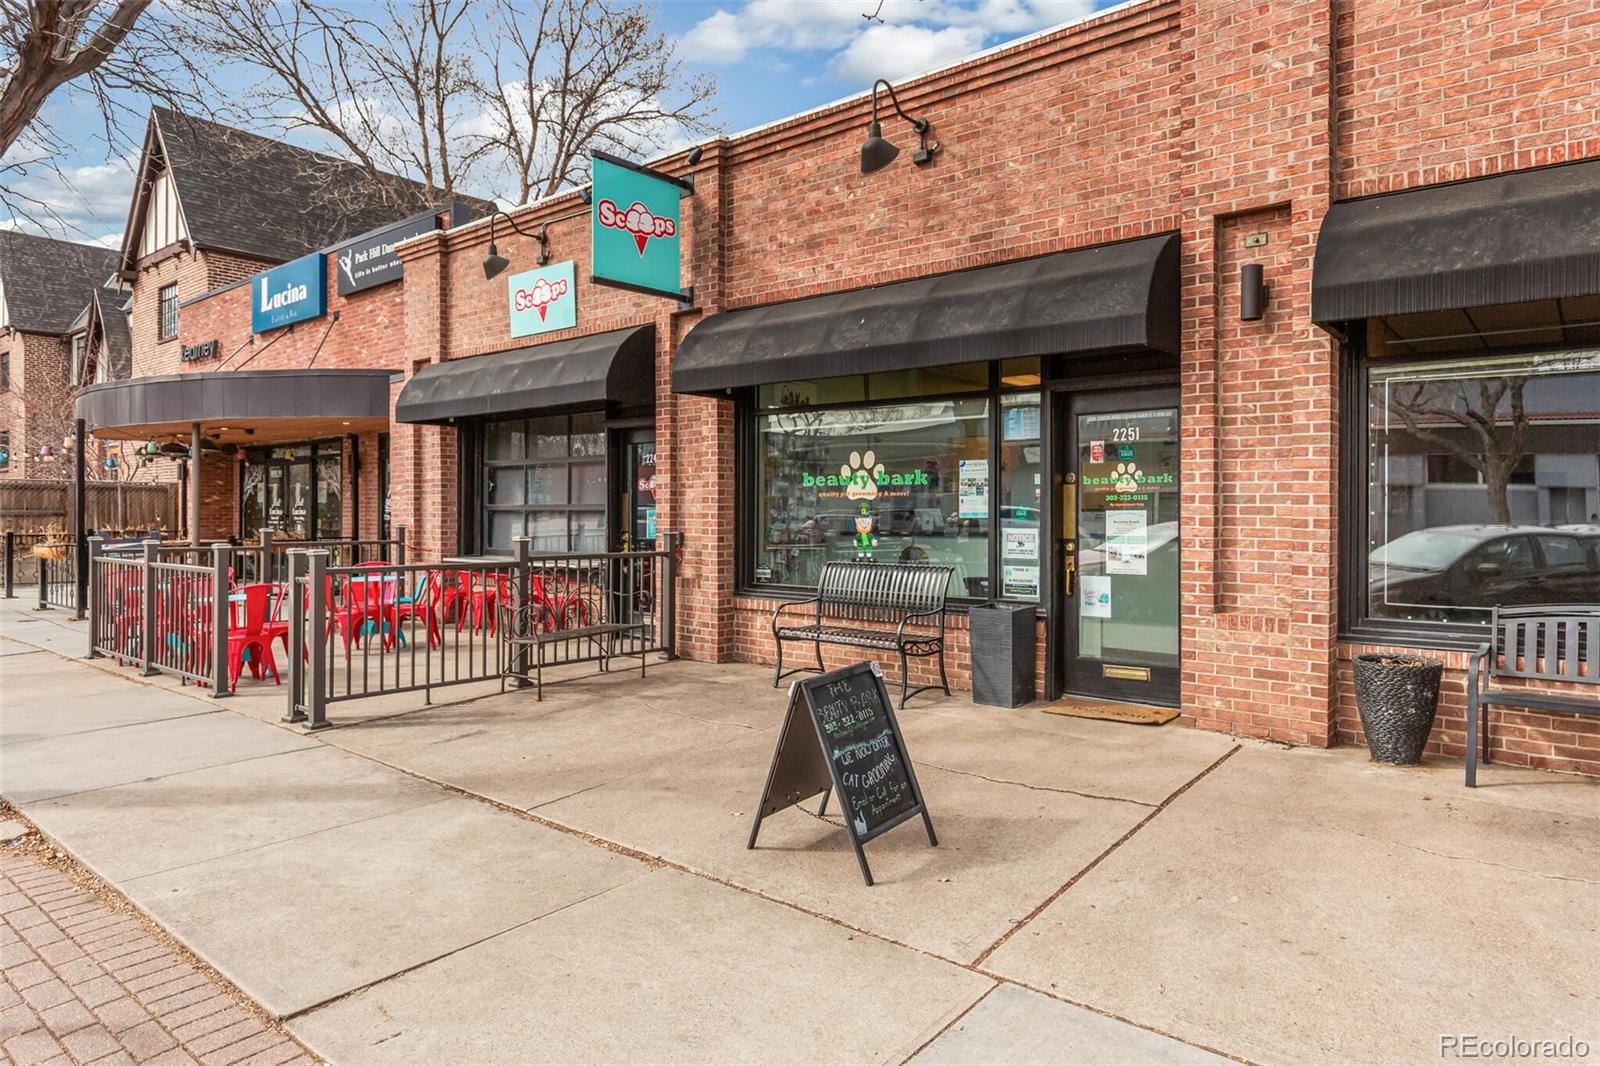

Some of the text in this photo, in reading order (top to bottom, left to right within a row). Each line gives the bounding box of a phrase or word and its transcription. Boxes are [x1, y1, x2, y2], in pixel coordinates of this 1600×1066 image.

[598, 199, 676, 238] Scoops
[355, 250, 369, 265] Park
[369, 245, 381, 259] Hill
[354, 270, 365, 279] Life
[372, 263, 388, 273] better
[260, 276, 308, 313] Lucina
[515, 278, 568, 312] Scoops
[1112, 427, 1140, 441] 2251
[802, 469, 928, 489] beauty bark
[1082, 473, 1173, 486] beauty bark
[826, 679, 852, 698] THE
[850, 688, 881, 713] BARK
[841, 751, 854, 766] WE
[855, 746, 872, 760] NOW
[842, 752, 896, 789] CAT GROOMING
